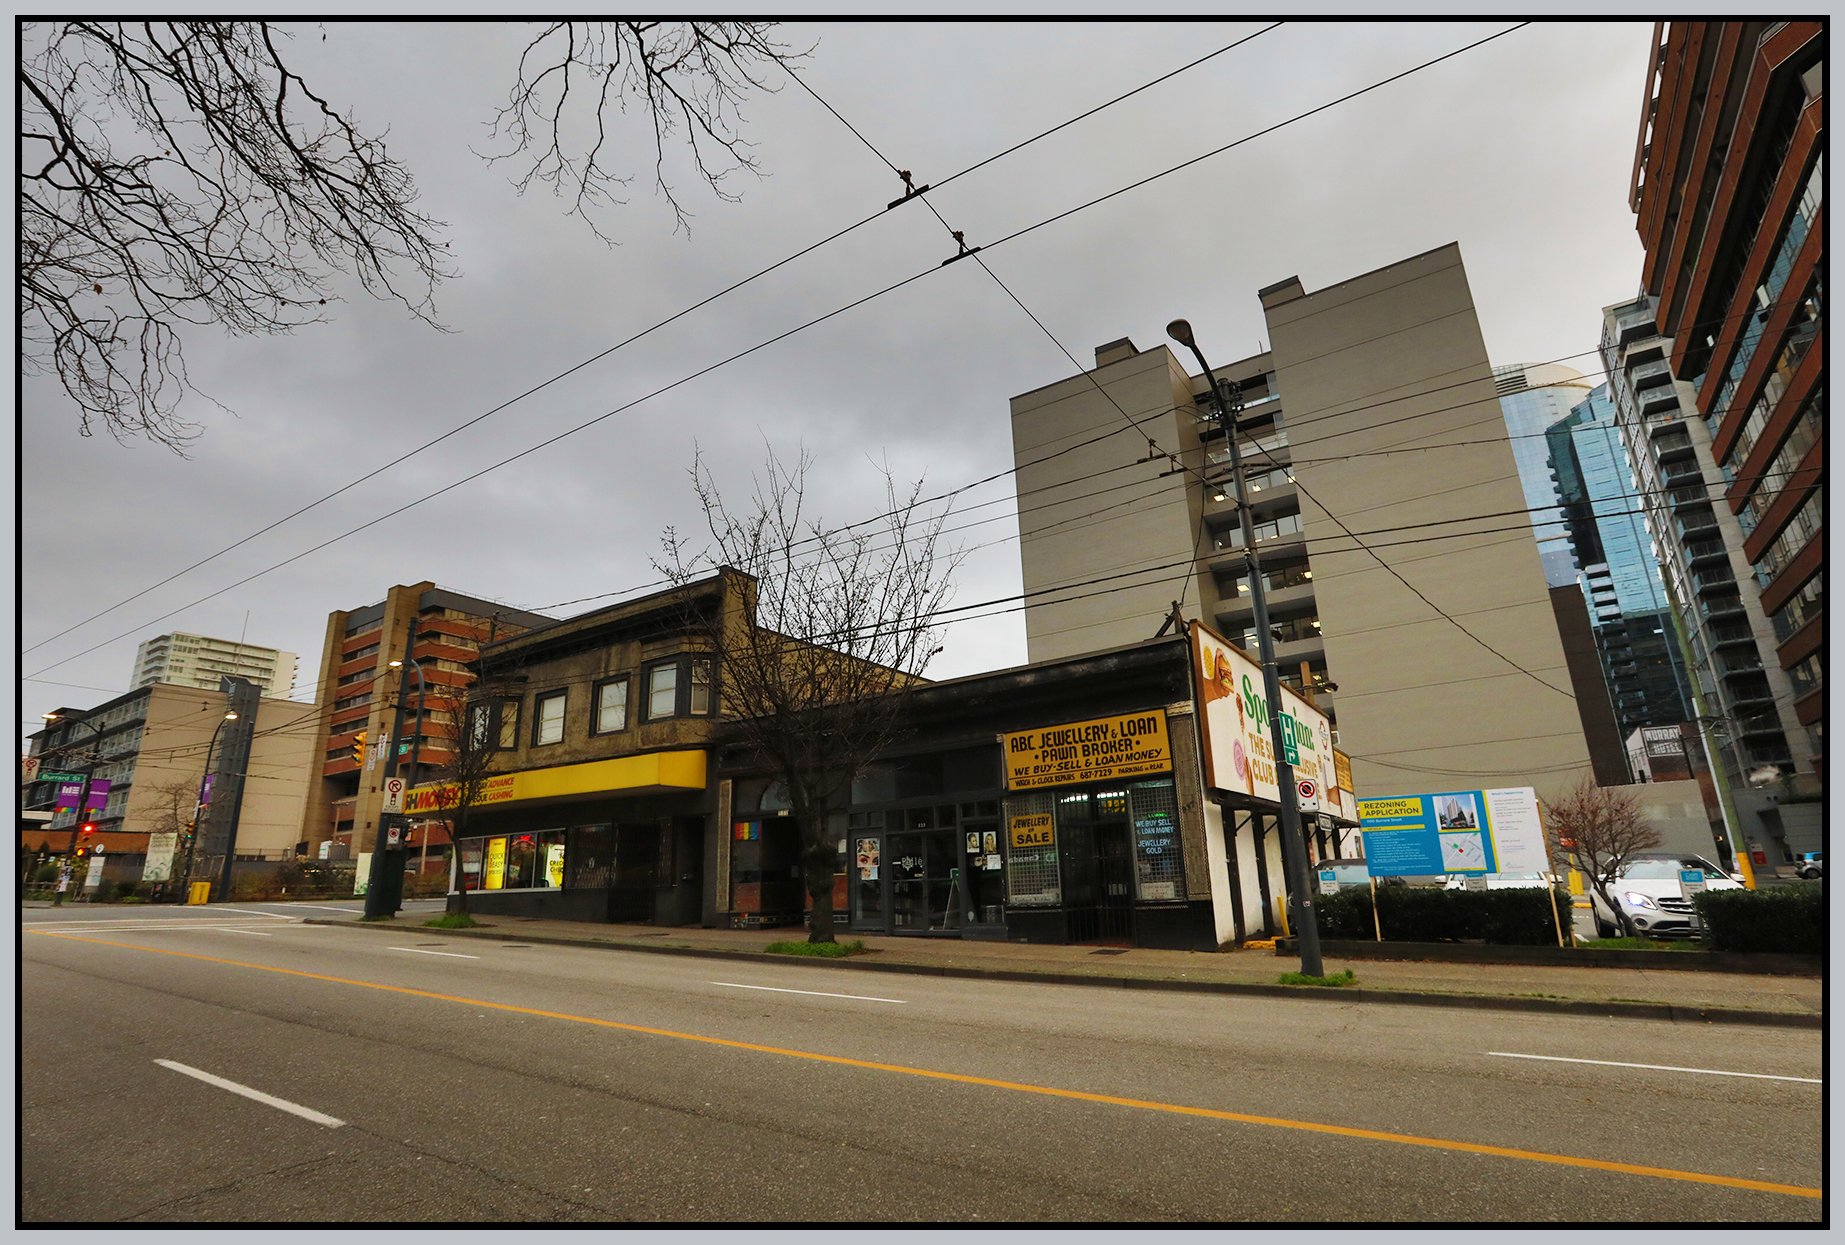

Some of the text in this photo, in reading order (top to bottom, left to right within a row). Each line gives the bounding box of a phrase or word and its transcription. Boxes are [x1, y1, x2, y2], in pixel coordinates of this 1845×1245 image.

[1011, 716, 1157, 753] ABC JEWELLERY & LOAN
[1645, 728, 1679, 741] MURRAY
[1042, 738, 1133, 762] PAWN BROKER
[1248, 732, 1265, 757] THE
[1654, 742, 1682, 754] HOTEL
[1014, 767, 1030, 776] WE
[1085, 758, 1092, 767] &
[1095, 754, 1123, 766] LOAN
[1125, 748, 1162, 762] MONEY
[1055, 774, 1075, 782] REPAIRS
[1080, 769, 1112, 779] 687-7229
[1118, 766, 1143, 774] PARKING
[1253, 759, 1275, 785] CLUB
[488, 777, 514, 788] ADVANCE
[489, 790, 513, 800] CASHING
[1364, 801, 1407, 809] REZONING
[1366, 807, 1419, 816] APPLICATION
[1013, 816, 1050, 829] JEWELLERY
[1017, 832, 1049, 844] SALE
[1138, 839, 1170, 848] JEWELLERY
